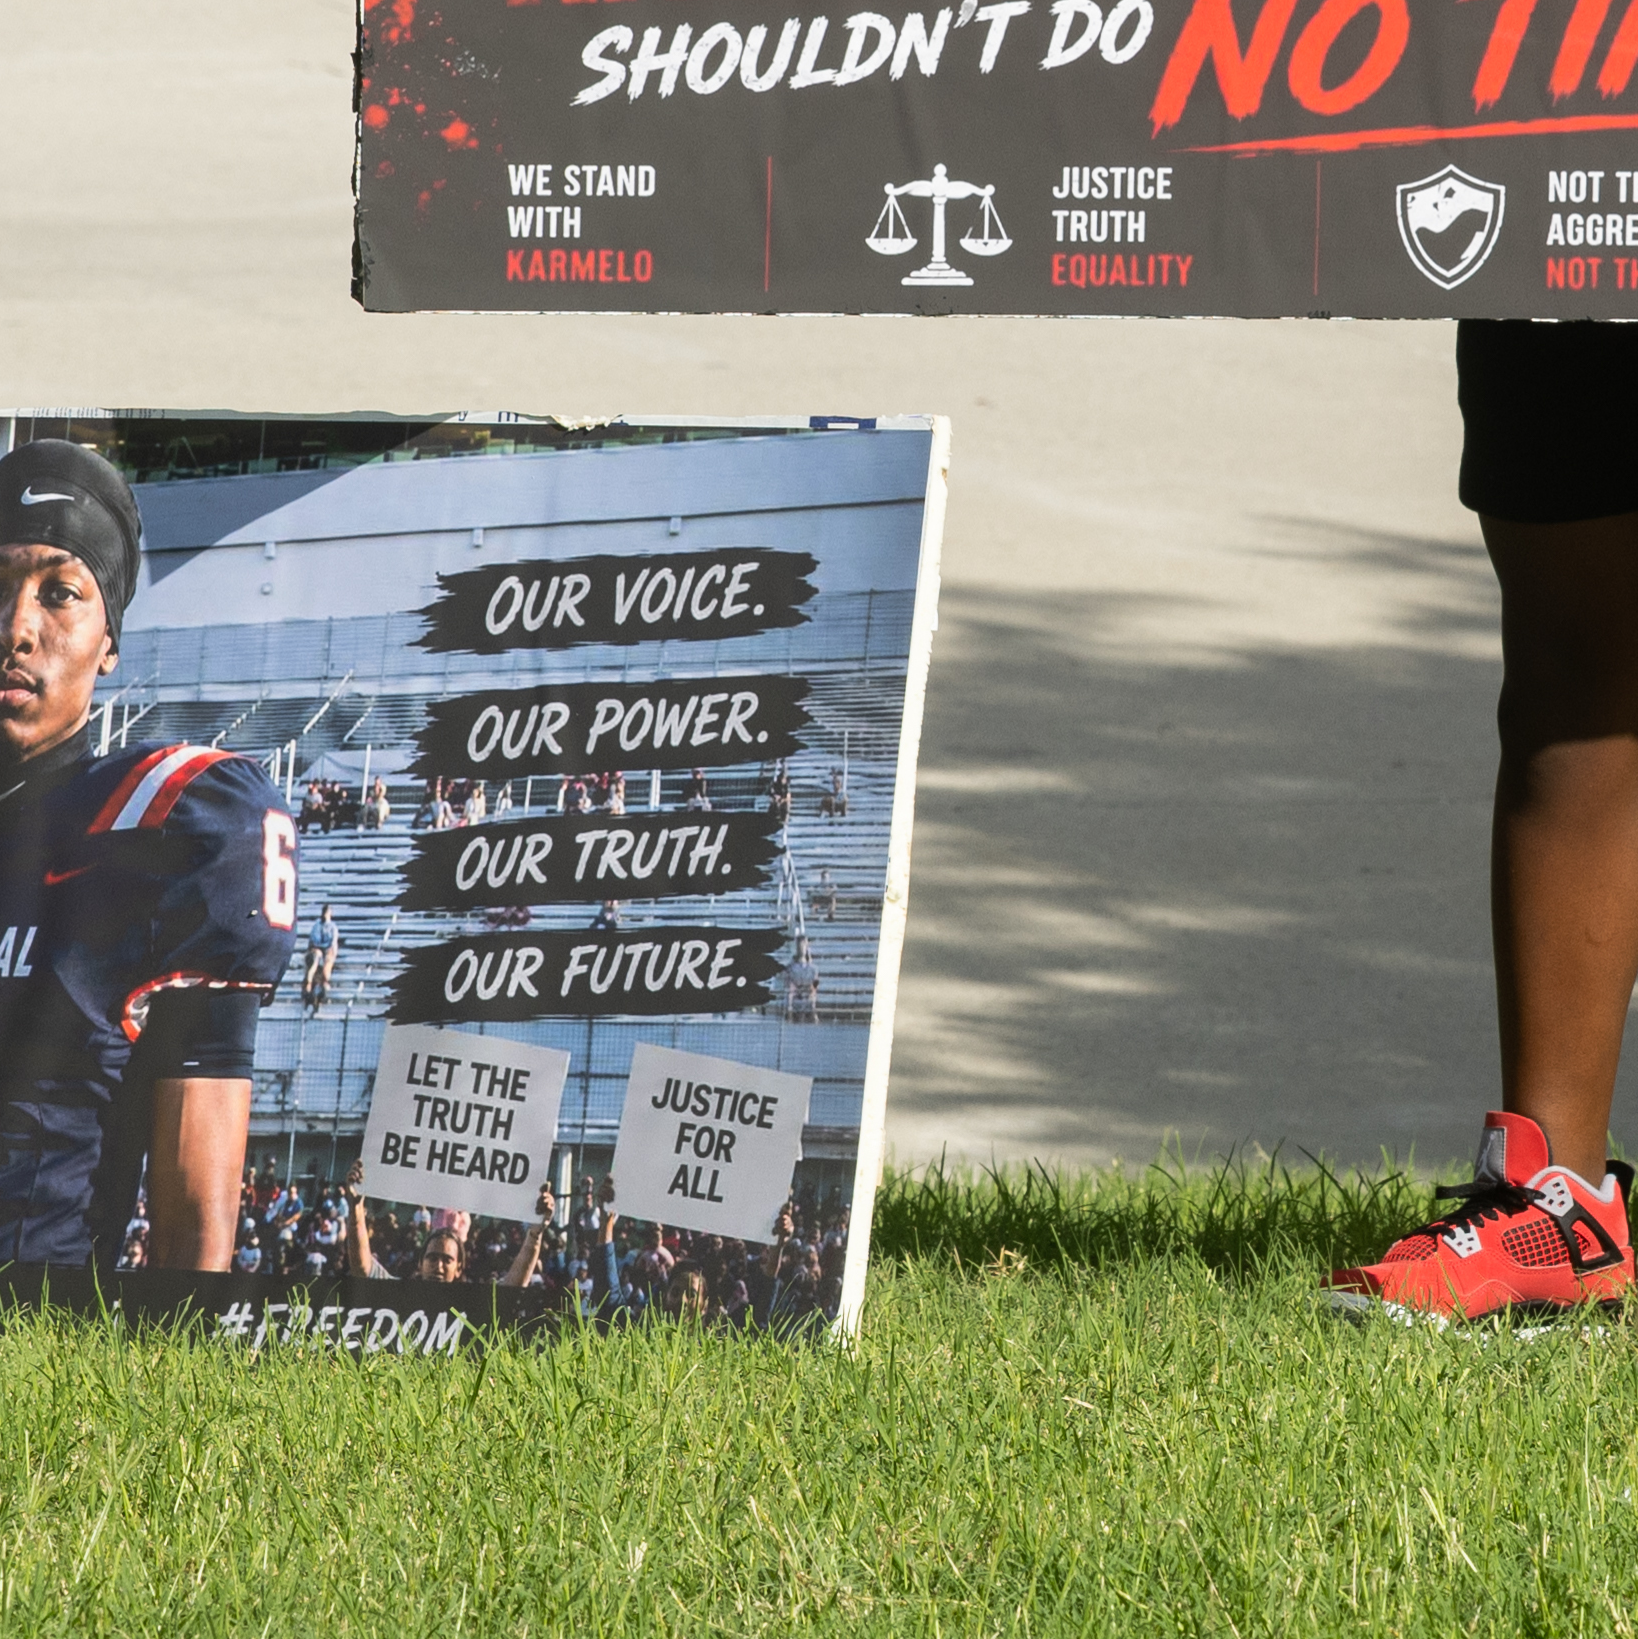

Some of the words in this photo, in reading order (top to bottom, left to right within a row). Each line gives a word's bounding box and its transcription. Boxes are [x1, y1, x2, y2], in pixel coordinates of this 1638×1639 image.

[509, 164, 552, 196] WE
[563, 164, 656, 197] STAND
[1052, 167, 1173, 200] JUSTICE
[1548, 171, 1603, 204] NOT
[507, 206, 581, 238] WITH
[1052, 210, 1146, 243] TRUTH
[506, 250, 652, 282] KARMELO
[1051, 254, 1192, 288] EQUALITY
[1546, 258, 1599, 290] NOT
[485, 573, 590, 635] OUR
[615, 562, 765, 625] VOICE.
[467, 702, 570, 762] OUR
[585, 691, 768, 755] POWER.
[262, 808, 298, 931] 6
[456, 833, 553, 890] OUR
[574, 824, 732, 882] TRUTH.
[444, 947, 544, 1002] OUR
[561, 939, 747, 996] FUTURE.
[407, 1053, 462, 1090] LET
[471, 1062, 531, 1102] THE
[413, 1094, 514, 1141] TRUTH
[651, 1077, 779, 1129] JUSTICE
[380, 1132, 421, 1168] BE
[426, 1140, 530, 1185] HEARD
[674, 1123, 736, 1162] FOR
[668, 1164, 724, 1203] ALL
